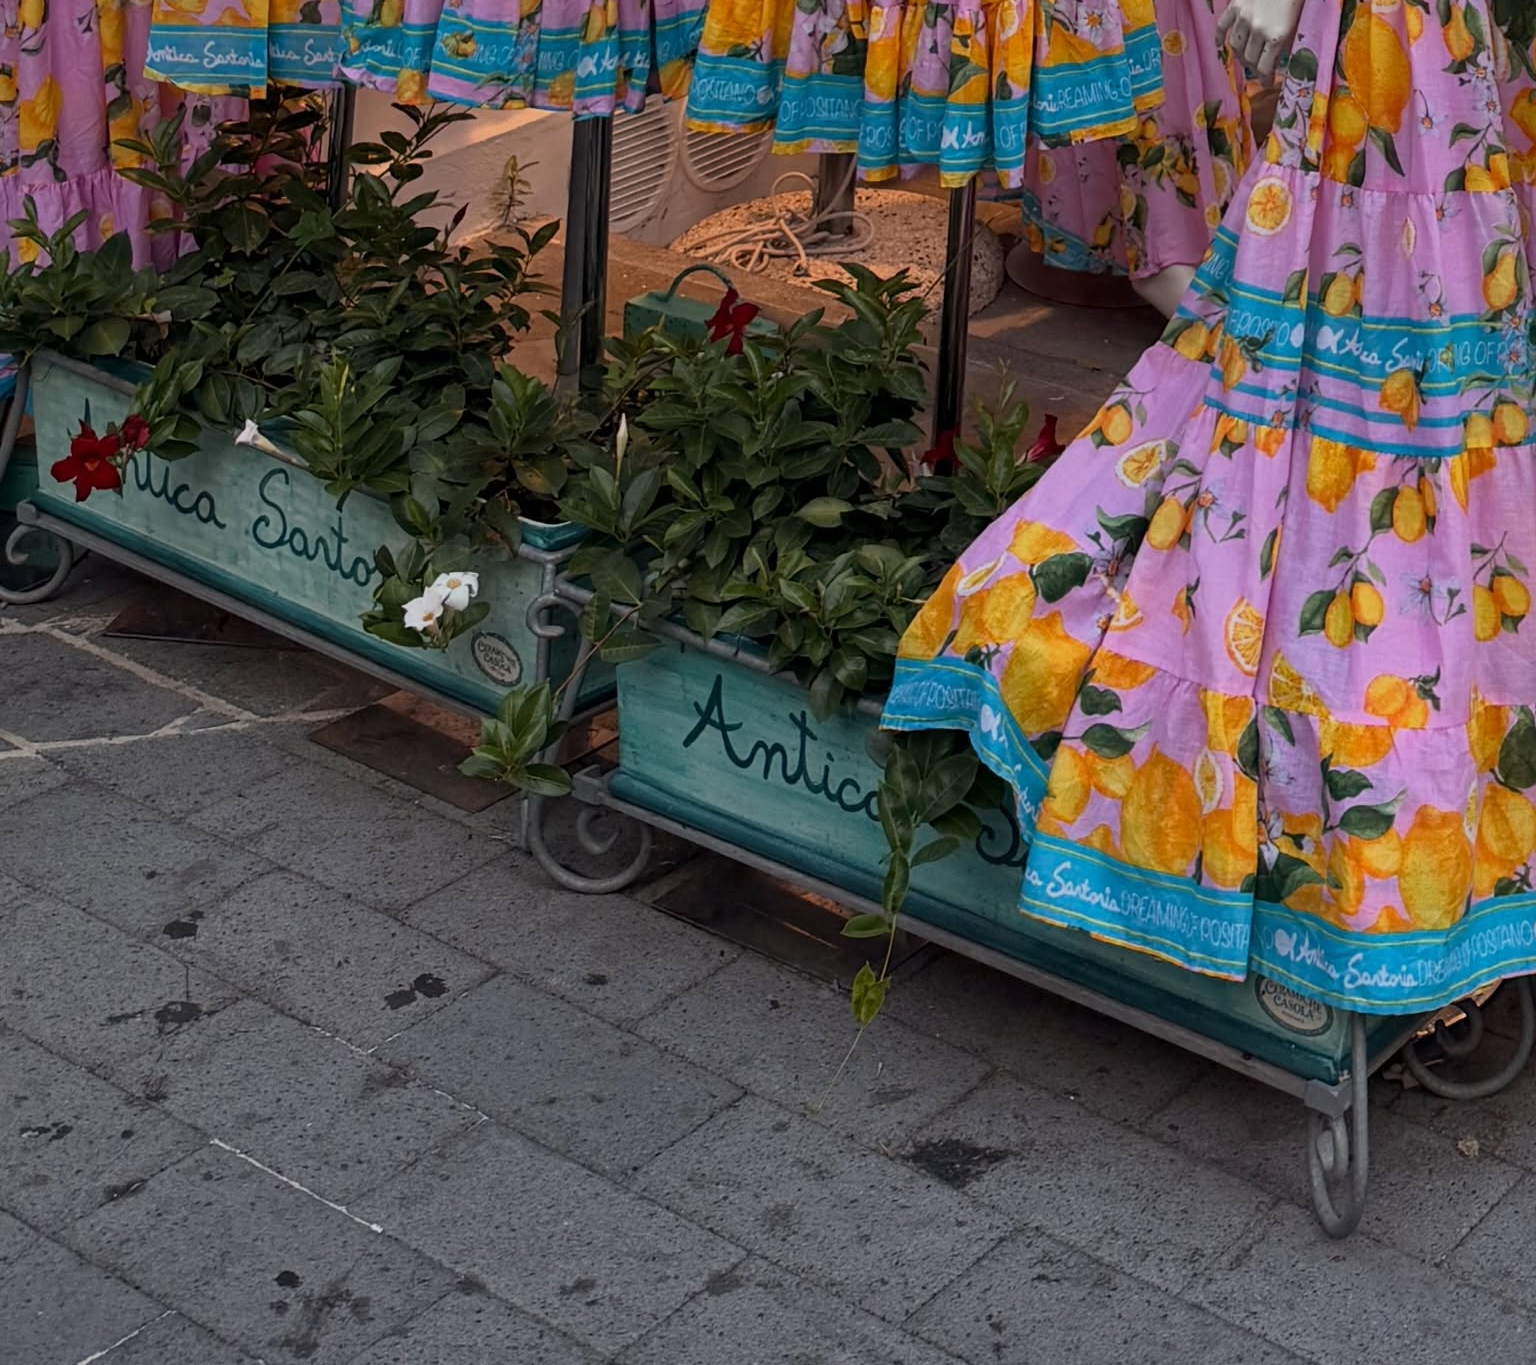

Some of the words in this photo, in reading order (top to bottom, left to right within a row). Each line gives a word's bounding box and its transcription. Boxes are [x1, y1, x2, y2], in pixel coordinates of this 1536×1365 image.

[1057, 78, 1119, 111] REAMING
[1046, 860, 1121, 914] Sartoria
[1120, 890, 1188, 937] DREAMING
[1343, 951, 1418, 989] Sartoria
[1273, 993, 1315, 1022] CASOLA
